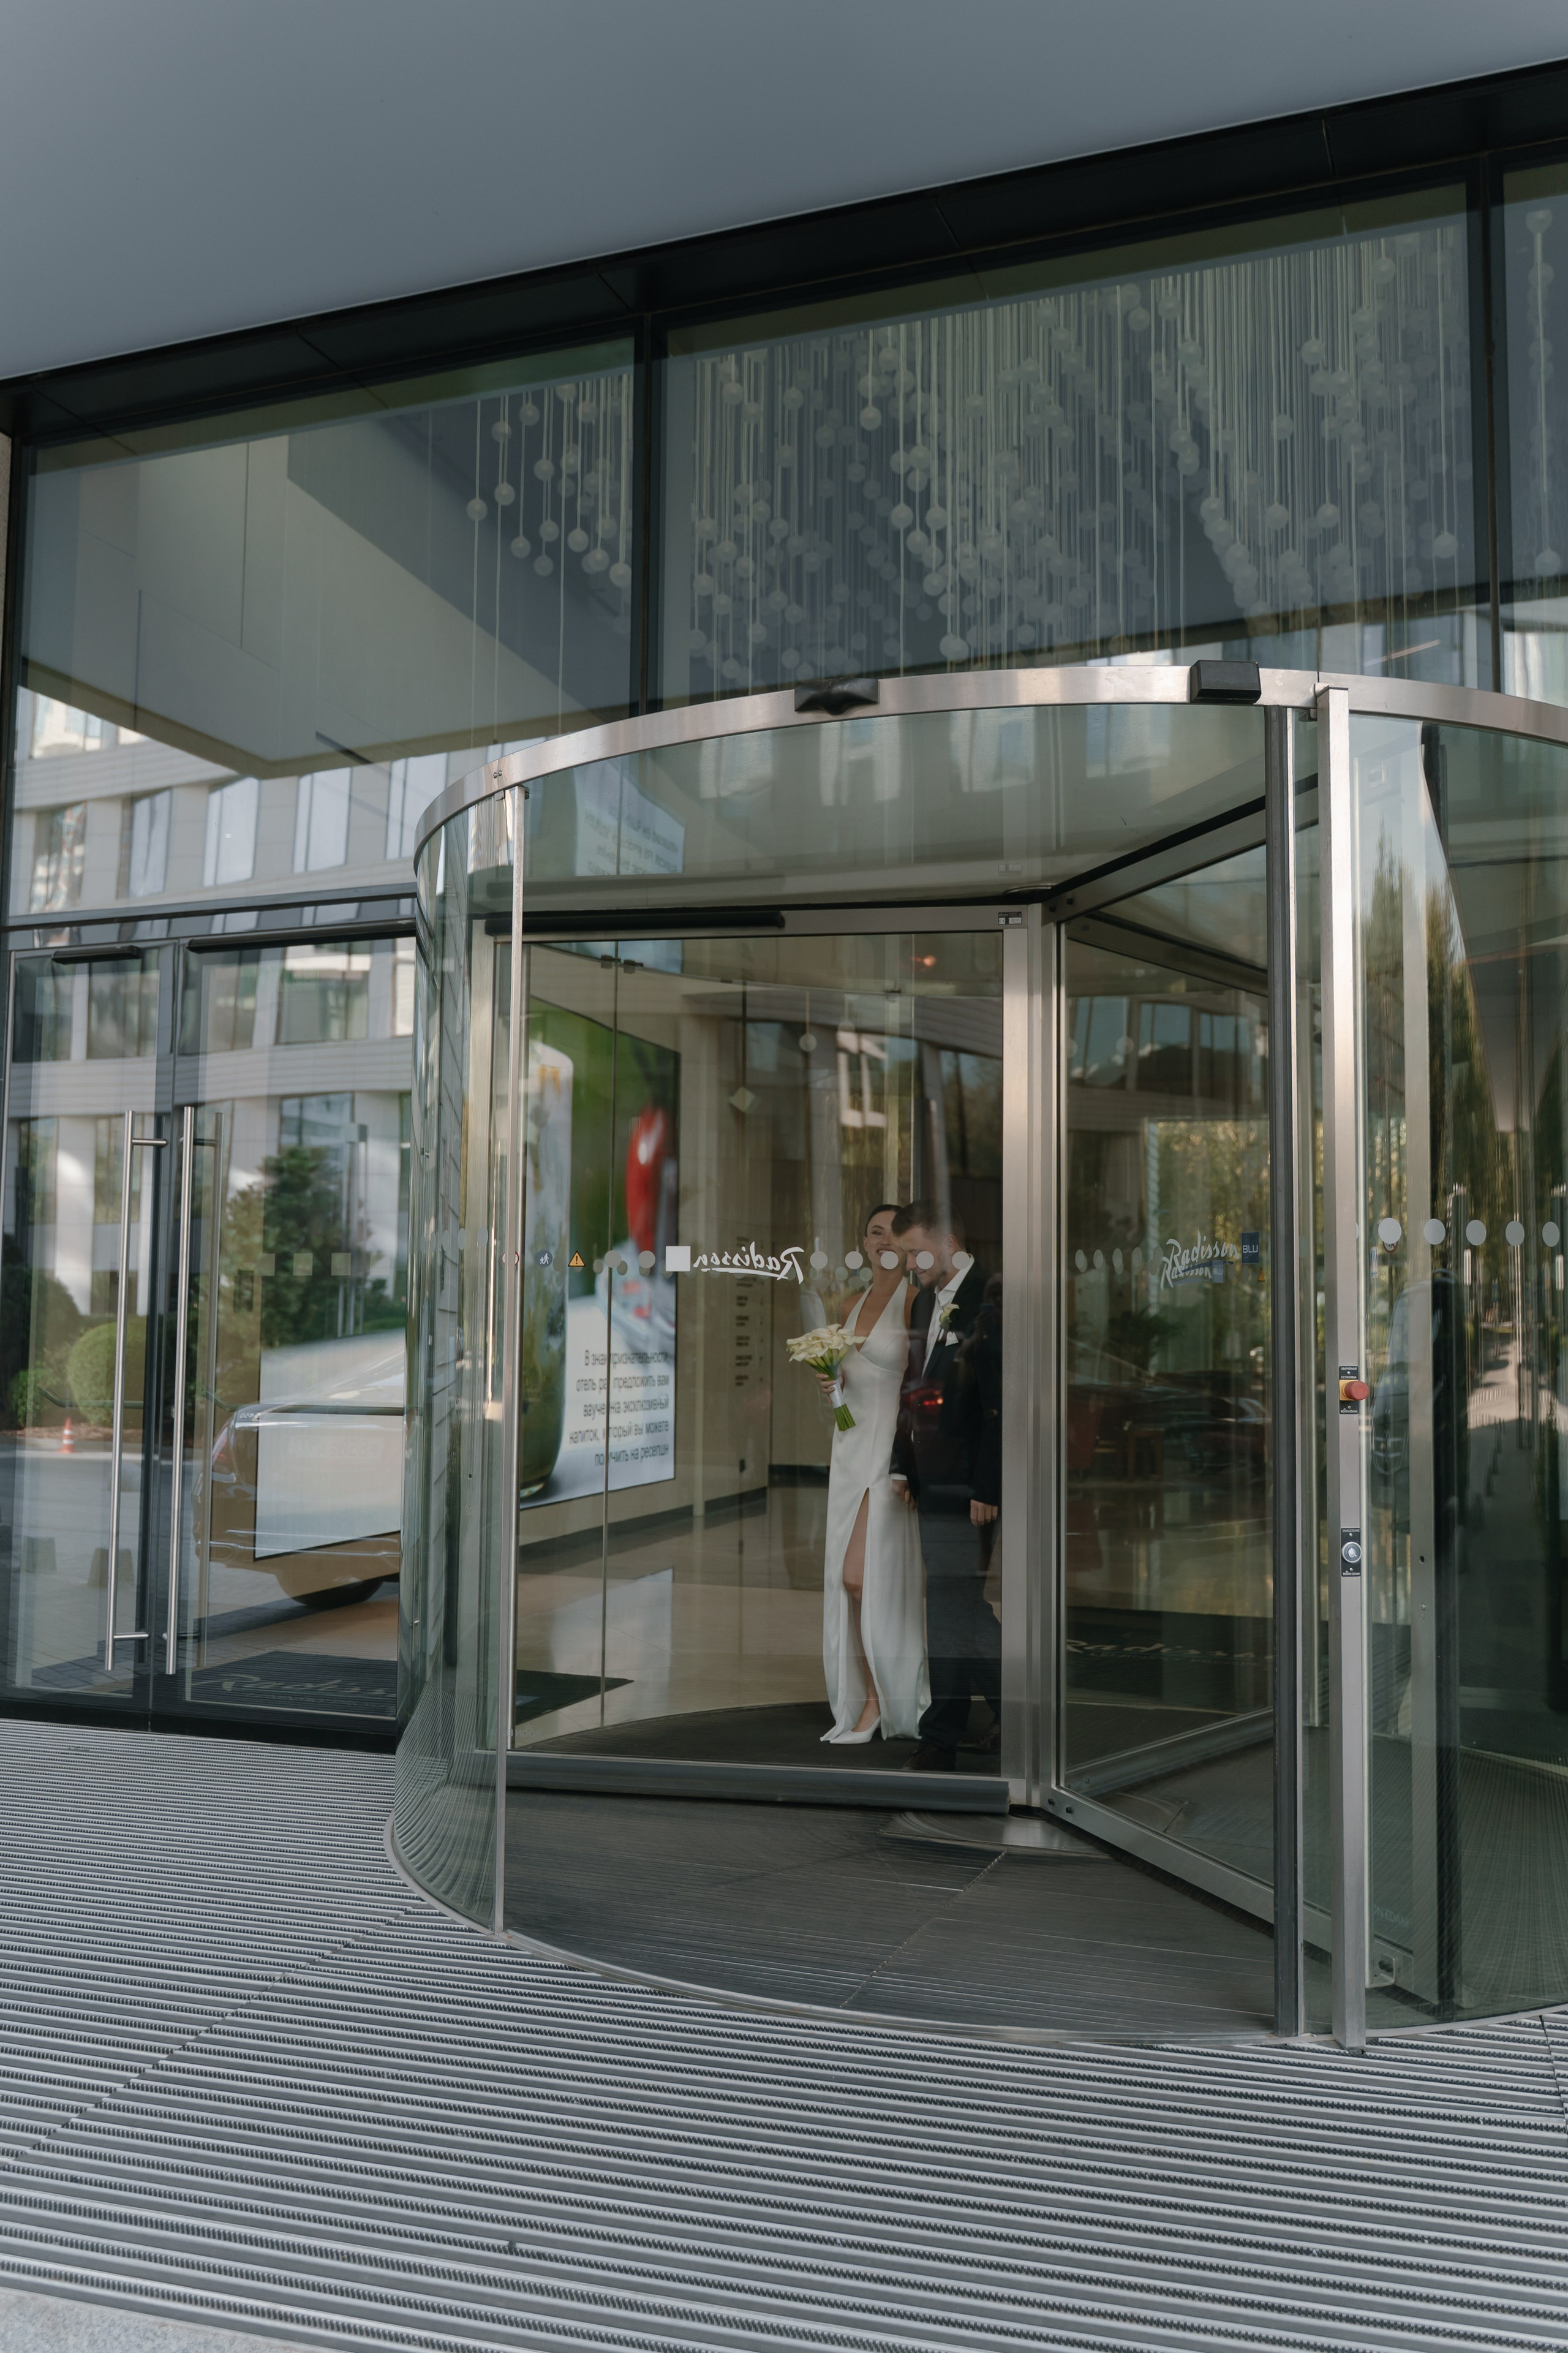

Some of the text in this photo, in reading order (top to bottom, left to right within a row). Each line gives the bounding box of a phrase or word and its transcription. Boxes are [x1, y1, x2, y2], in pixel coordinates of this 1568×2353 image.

[1166, 1230, 1239, 1277] Radisson
[576, 1378, 596, 1391] отель
[584, 1403, 607, 1420] вауче
[646, 1421, 669, 1433] можете
